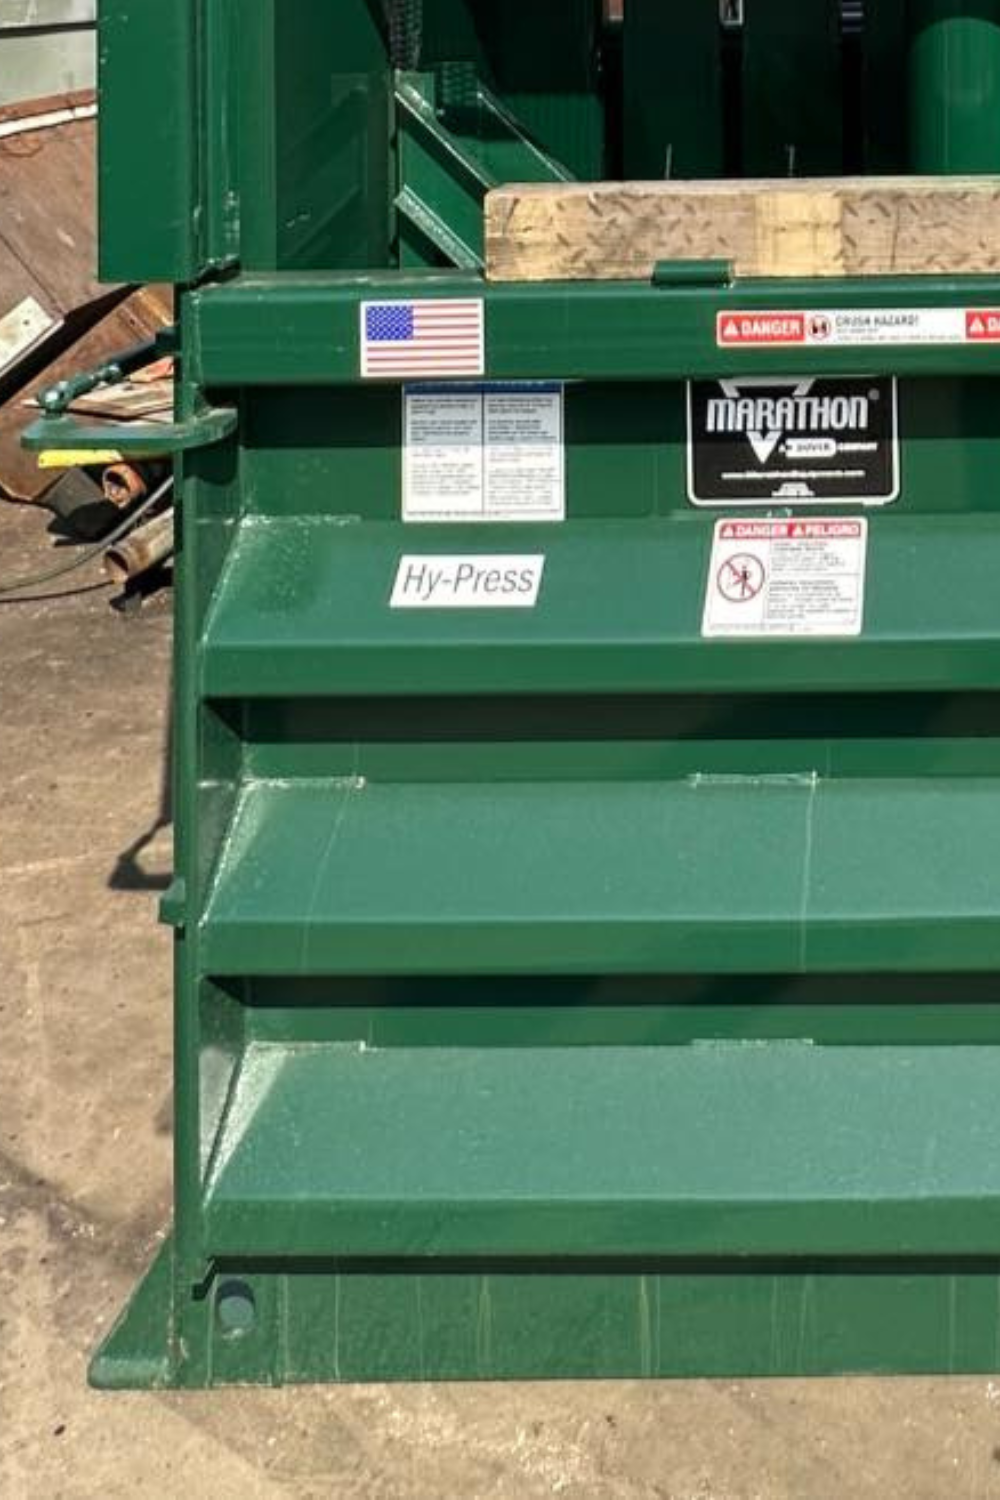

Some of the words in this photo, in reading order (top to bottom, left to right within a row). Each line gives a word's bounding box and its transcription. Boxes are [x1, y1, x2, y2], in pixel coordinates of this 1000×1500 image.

[741, 319, 800, 336] DANGER
[706, 396, 868, 431] MARATHON
[402, 563, 536, 600] Hy-Press
